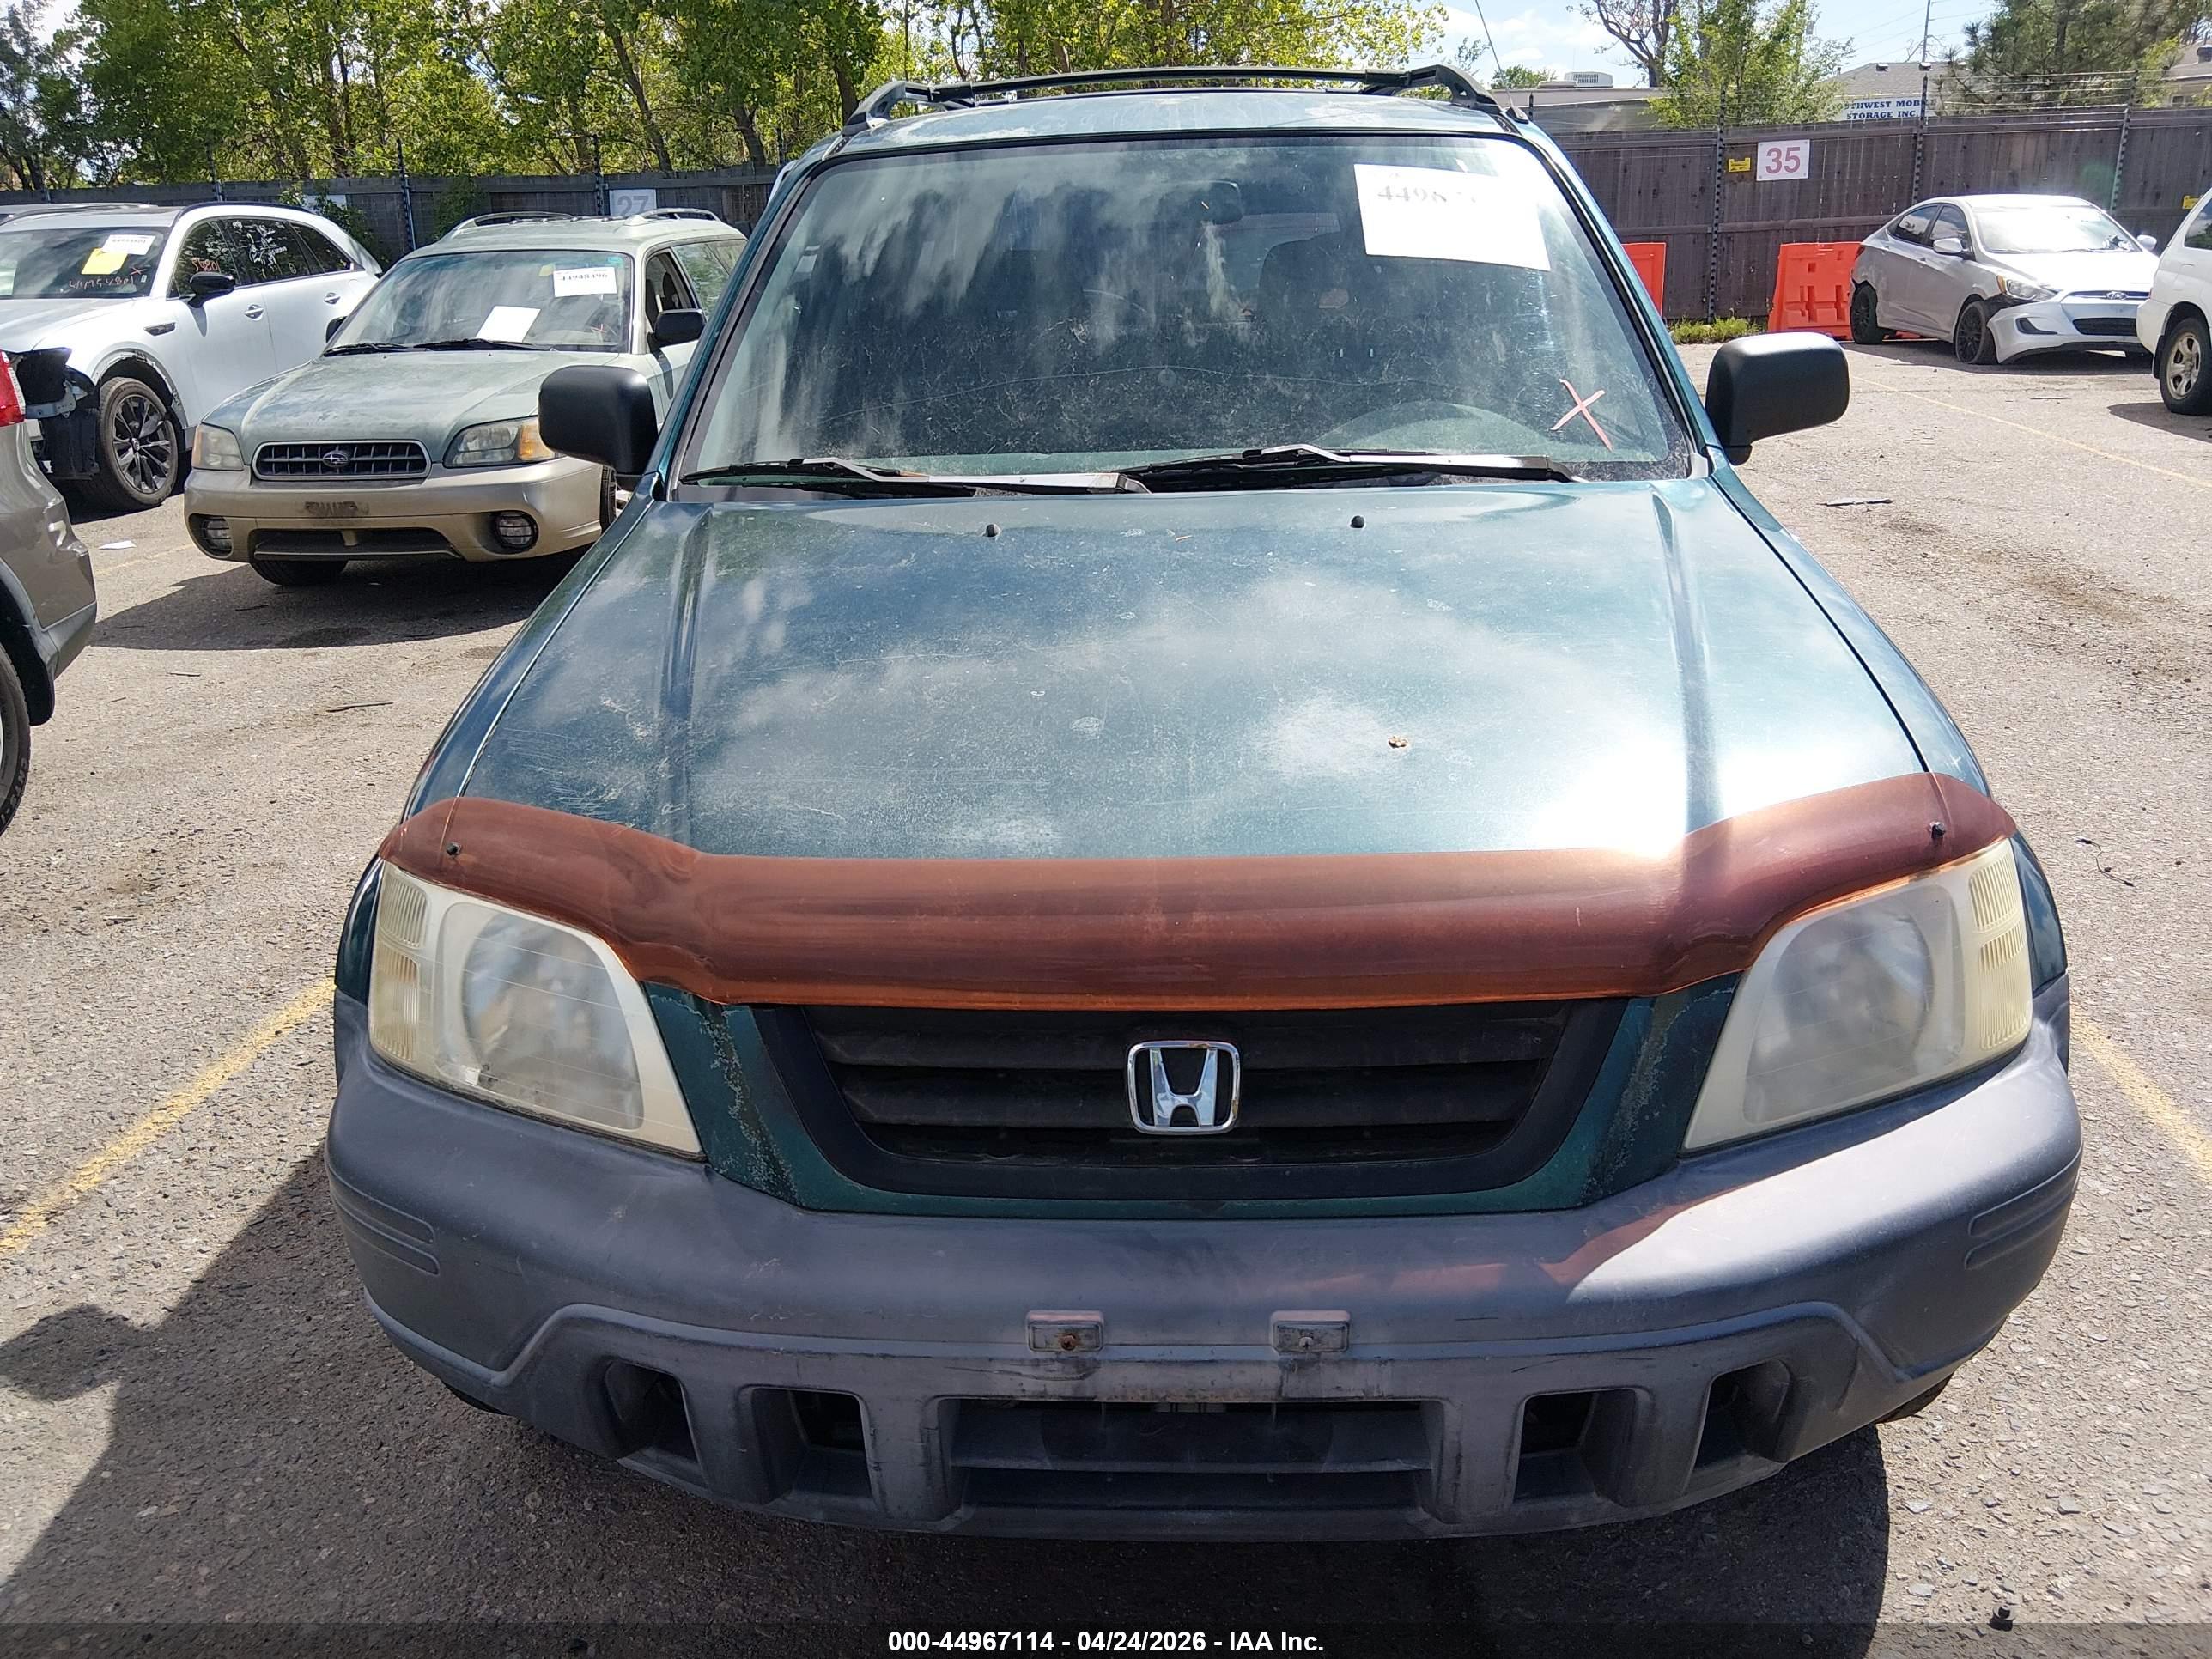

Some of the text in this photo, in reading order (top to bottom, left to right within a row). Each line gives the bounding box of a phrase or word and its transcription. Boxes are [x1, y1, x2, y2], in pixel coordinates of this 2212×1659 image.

[1846, 111, 1893, 120] STORAGE
[1765, 146, 1801, 174] 35
[617, 195, 649, 216] 27
